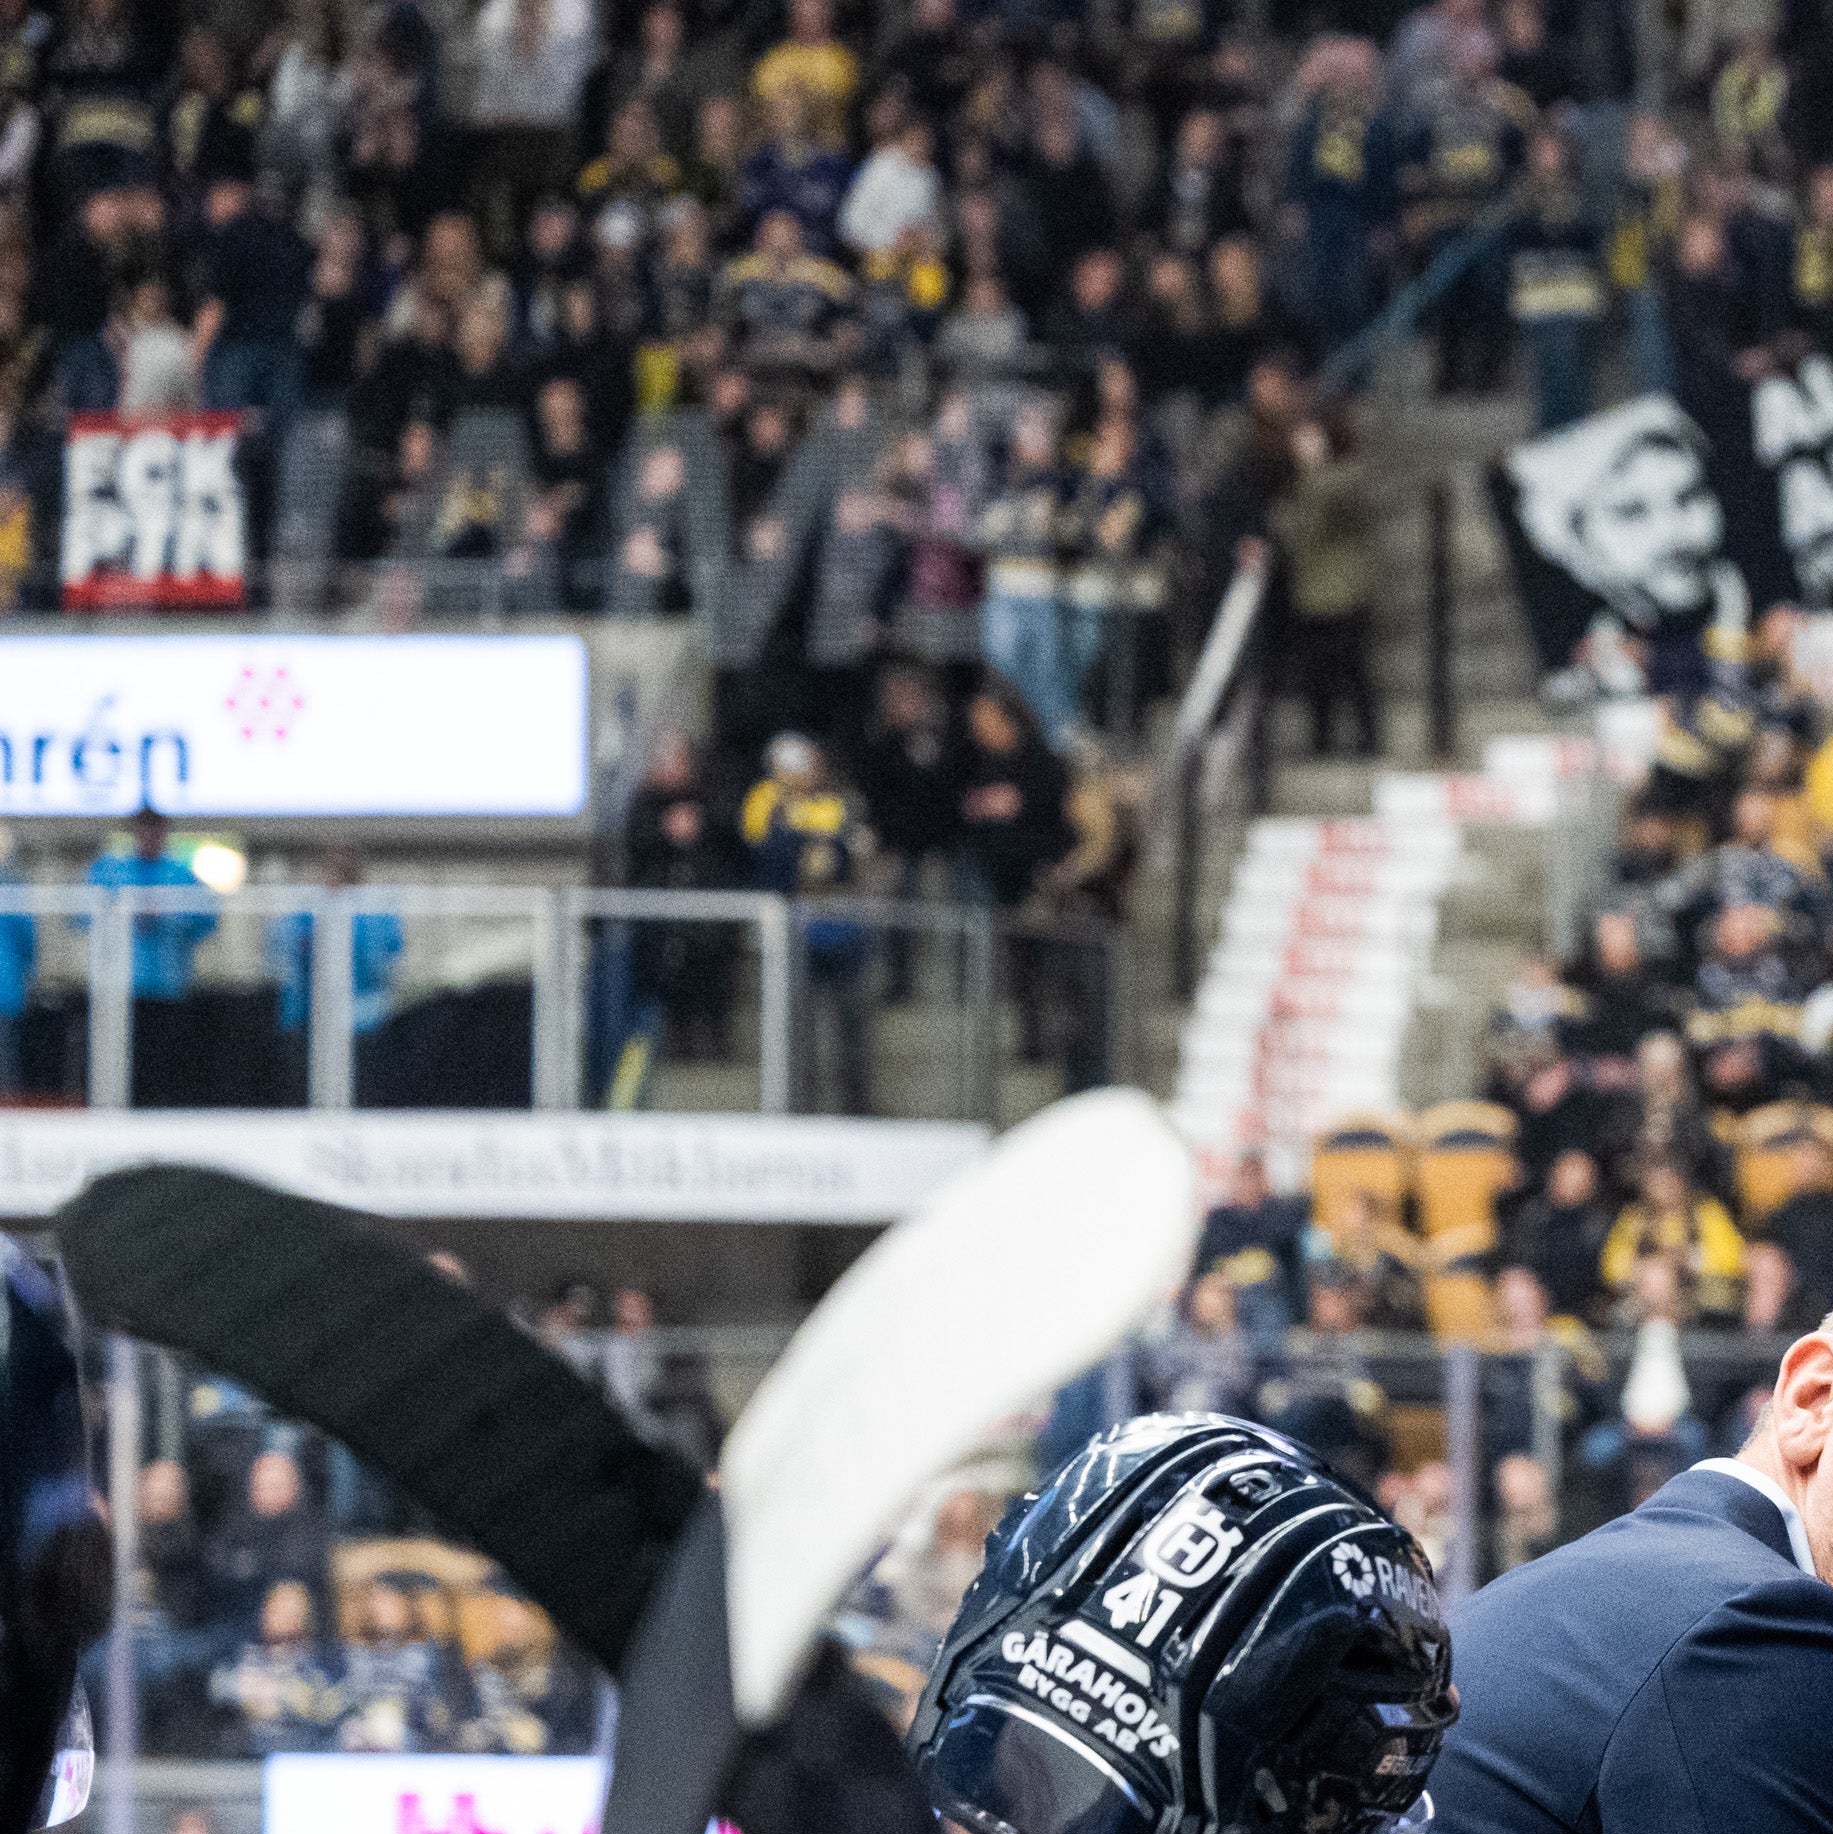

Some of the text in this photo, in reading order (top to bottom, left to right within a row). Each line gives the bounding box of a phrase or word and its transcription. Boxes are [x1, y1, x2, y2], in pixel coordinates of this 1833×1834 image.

[1102, 1568, 1184, 1648] 41
[1001, 1630, 1181, 1758] GÄRAHOVS
[1017, 1663, 1141, 1754] BYGG AB
